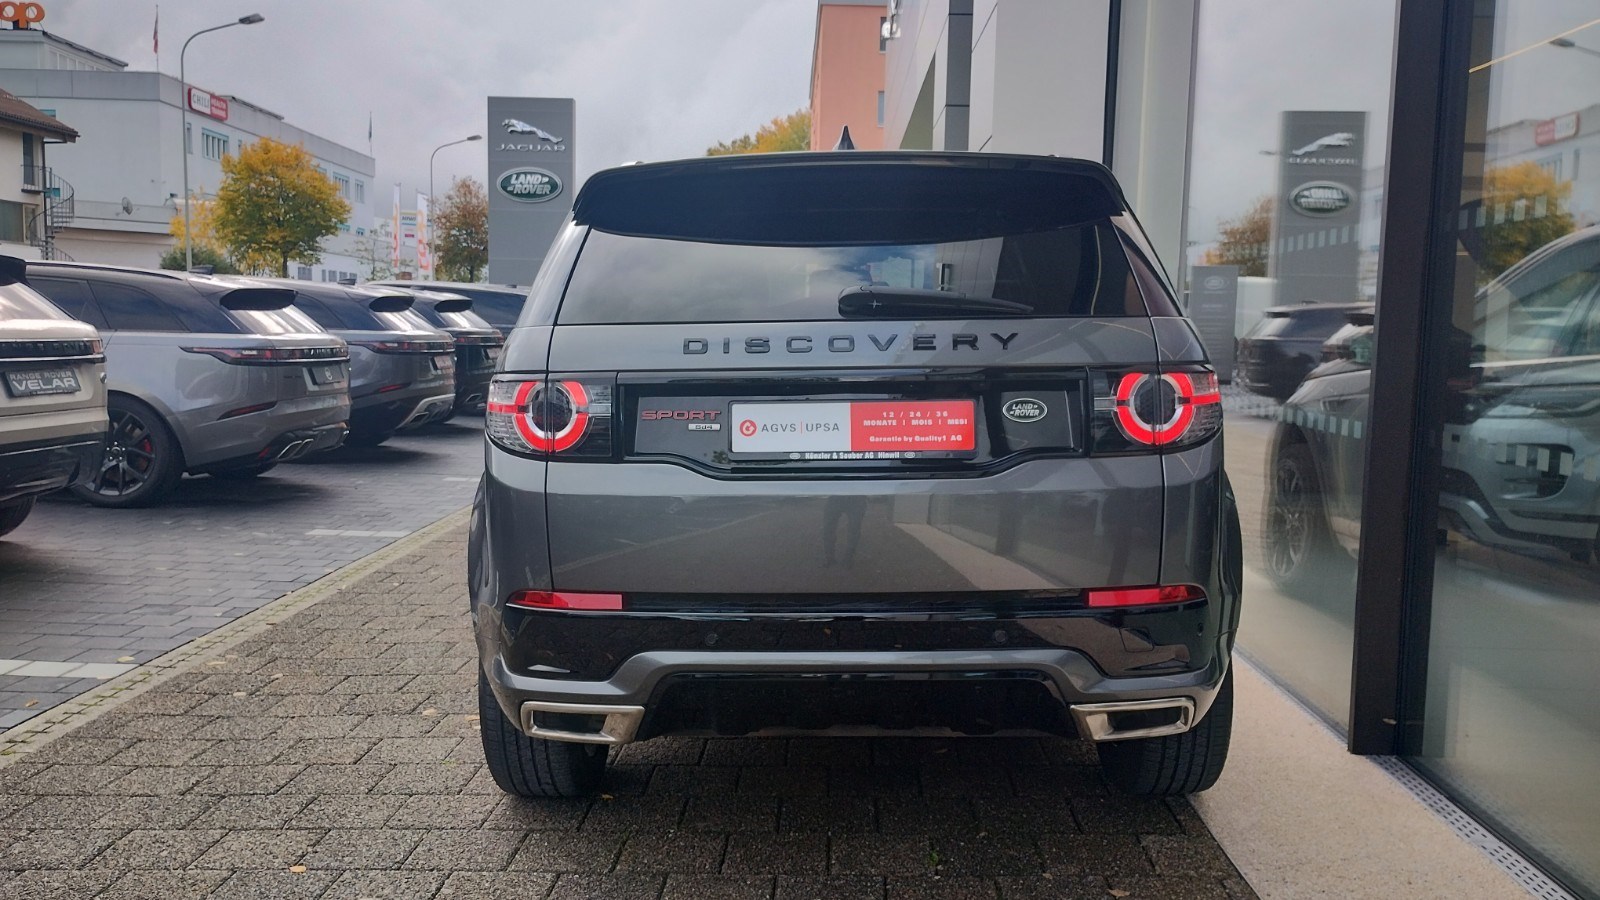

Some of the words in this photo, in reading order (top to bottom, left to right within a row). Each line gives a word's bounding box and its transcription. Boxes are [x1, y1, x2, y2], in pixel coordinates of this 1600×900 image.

[192, 93, 210, 108] CHILI
[496, 143, 566, 152] JAGUAR
[510, 173, 542, 185] LAND
[513, 184, 552, 195] ROVER
[682, 332, 1019, 355] DISCOVERY
[9, 371, 42, 381] RANGE
[43, 370, 73, 379] ROVER
[12, 377, 76, 391] VELAR
[641, 410, 721, 420] SPORT
[1014, 409, 1040, 417] ROVER
[761, 423, 797, 433] AGVS
[805, 422, 840, 432] UPSA
[911, 418, 933, 426] MOIS
[903, 435, 913, 443] by
[950, 434, 963, 442] AG
[864, 451, 874, 459] AG
